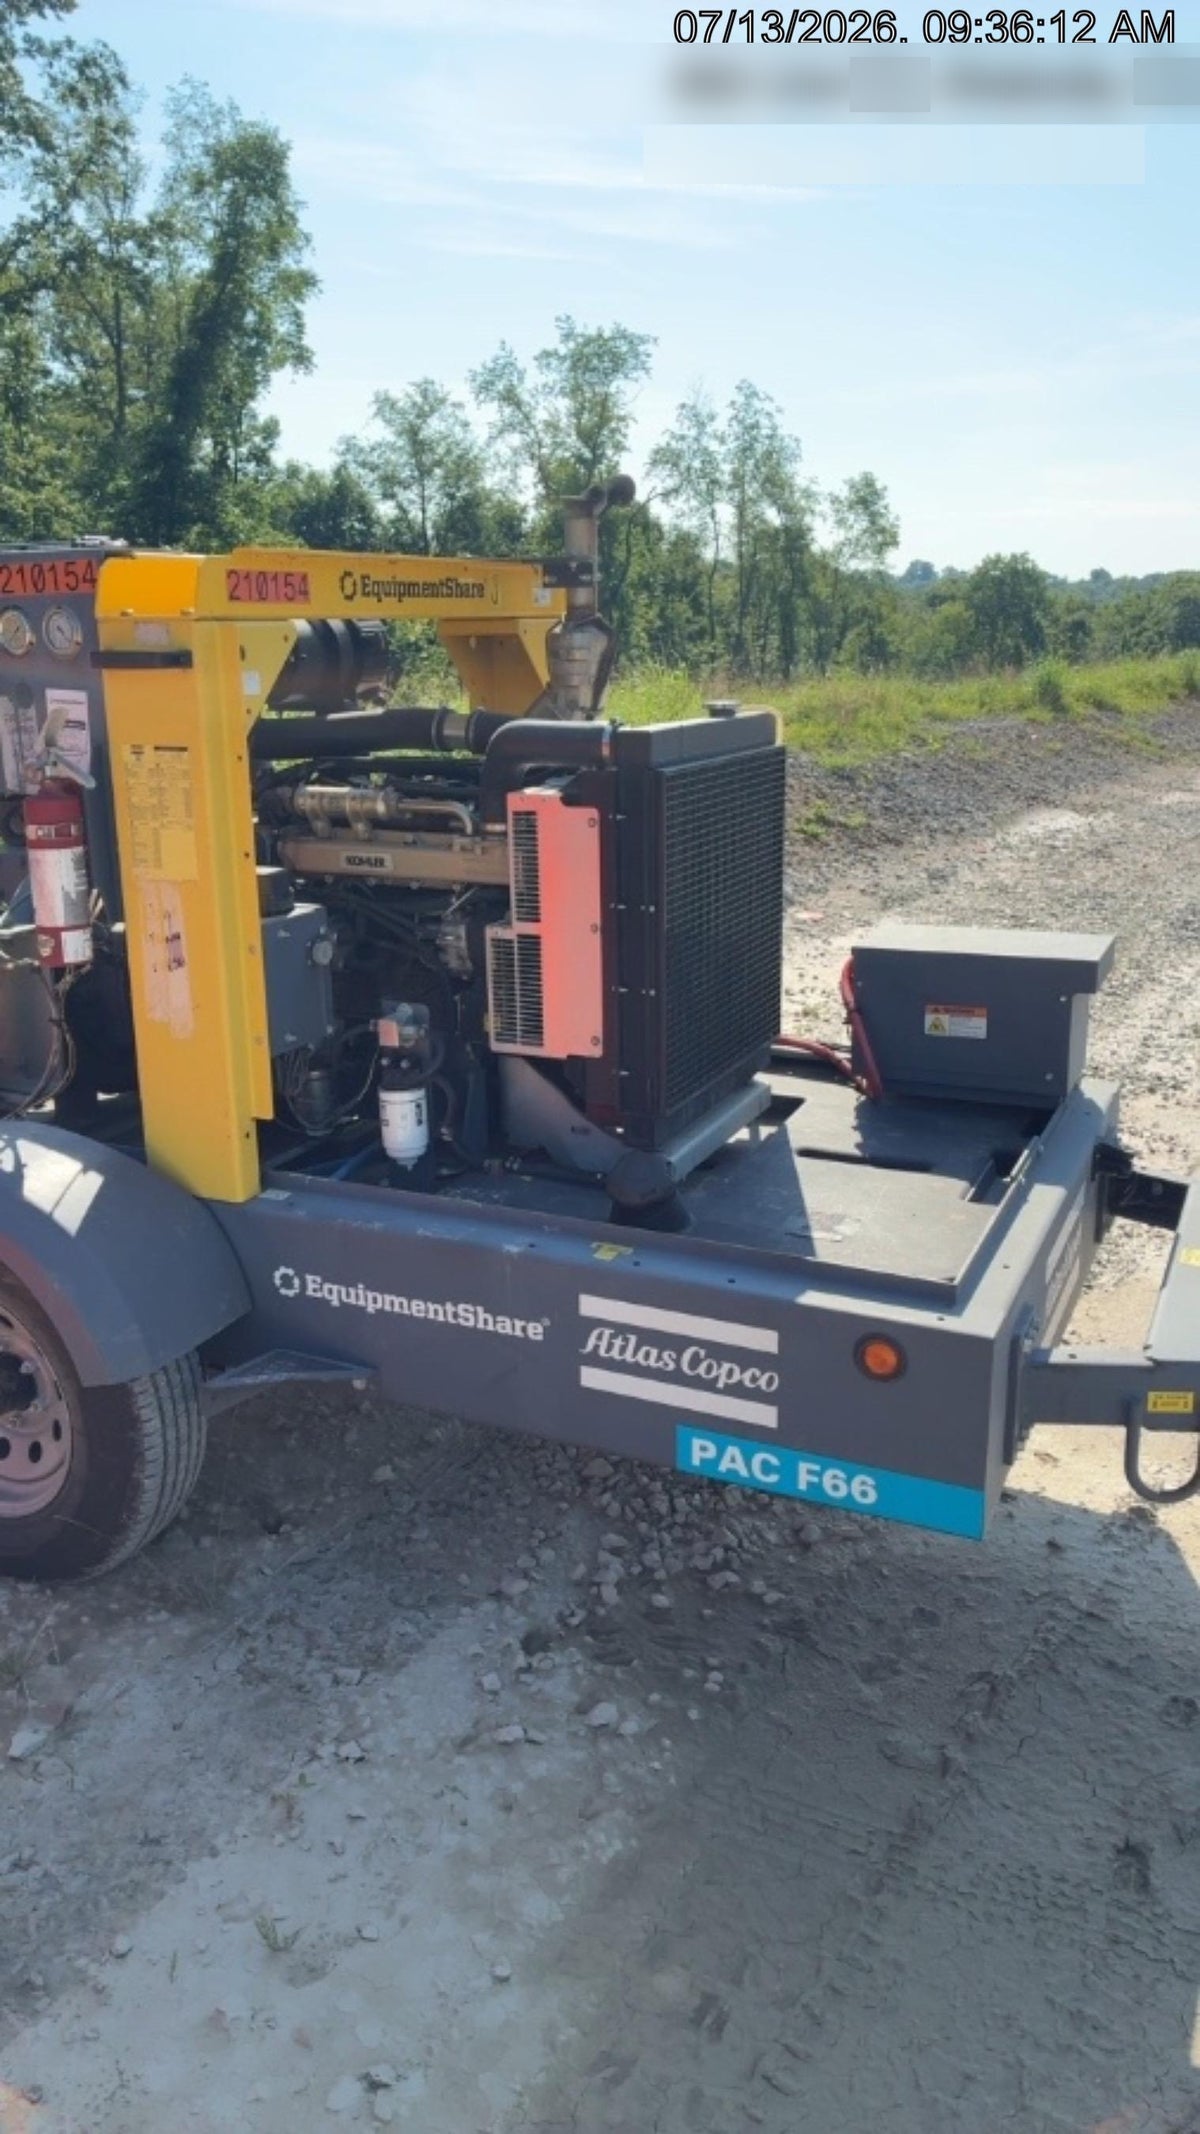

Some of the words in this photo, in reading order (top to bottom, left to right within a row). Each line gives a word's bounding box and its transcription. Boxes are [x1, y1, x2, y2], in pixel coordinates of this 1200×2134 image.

[0, 559, 97, 593] 210154
[226, 569, 309, 602] 210154
[579, 1326, 676, 1371] Atlas
[680, 1346, 780, 1393] Copco
[691, 1437, 781, 1483] PAC
[797, 1460, 878, 1504] F66
